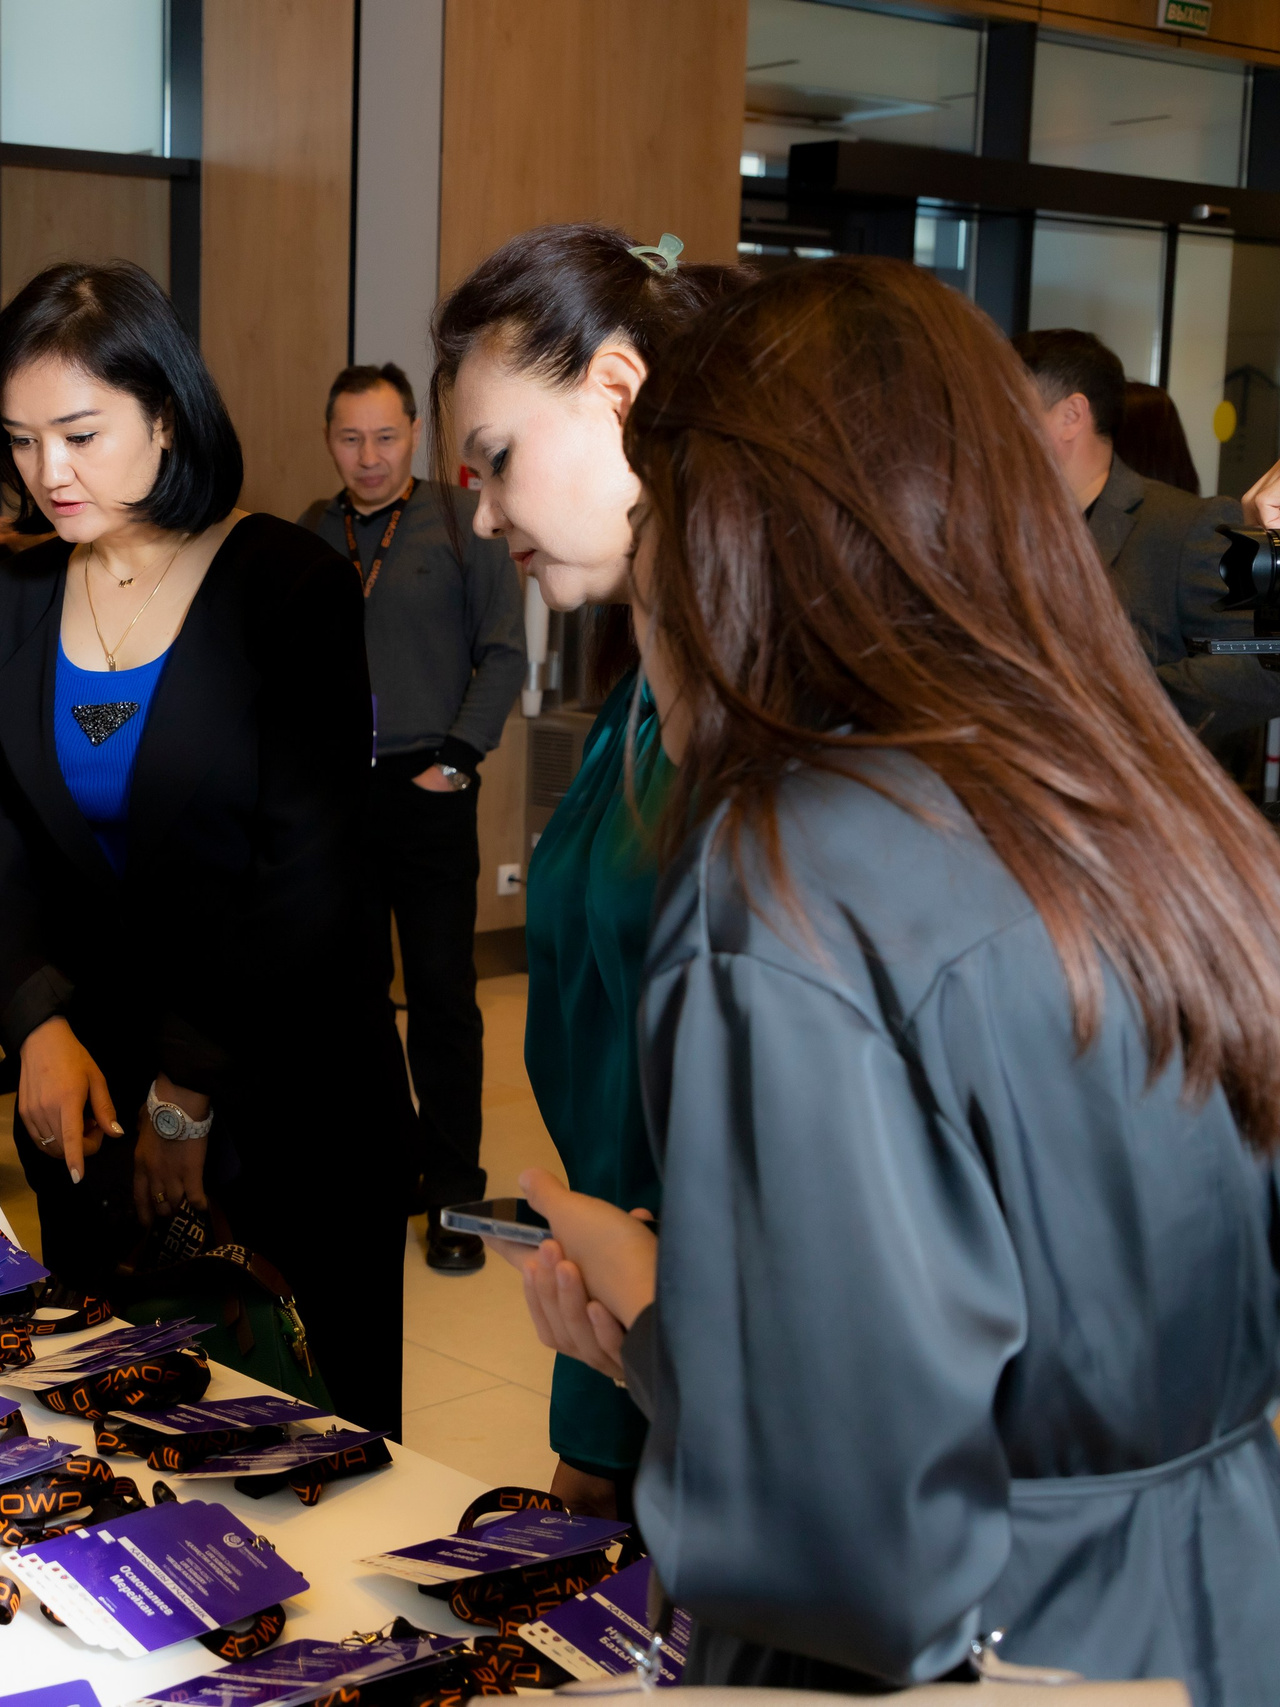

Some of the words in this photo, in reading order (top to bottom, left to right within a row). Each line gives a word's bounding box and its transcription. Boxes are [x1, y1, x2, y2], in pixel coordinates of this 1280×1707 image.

[1167, 3, 1208, 26] ВЫХОД
[107, 1574, 157, 1616] Мерейхан
[117, 1564, 175, 1616] Осмоналиев
[128, 1546, 169, 1582] ҚАТЫСУШЫ
[169, 1585, 207, 1618] УЧАСТНИК
